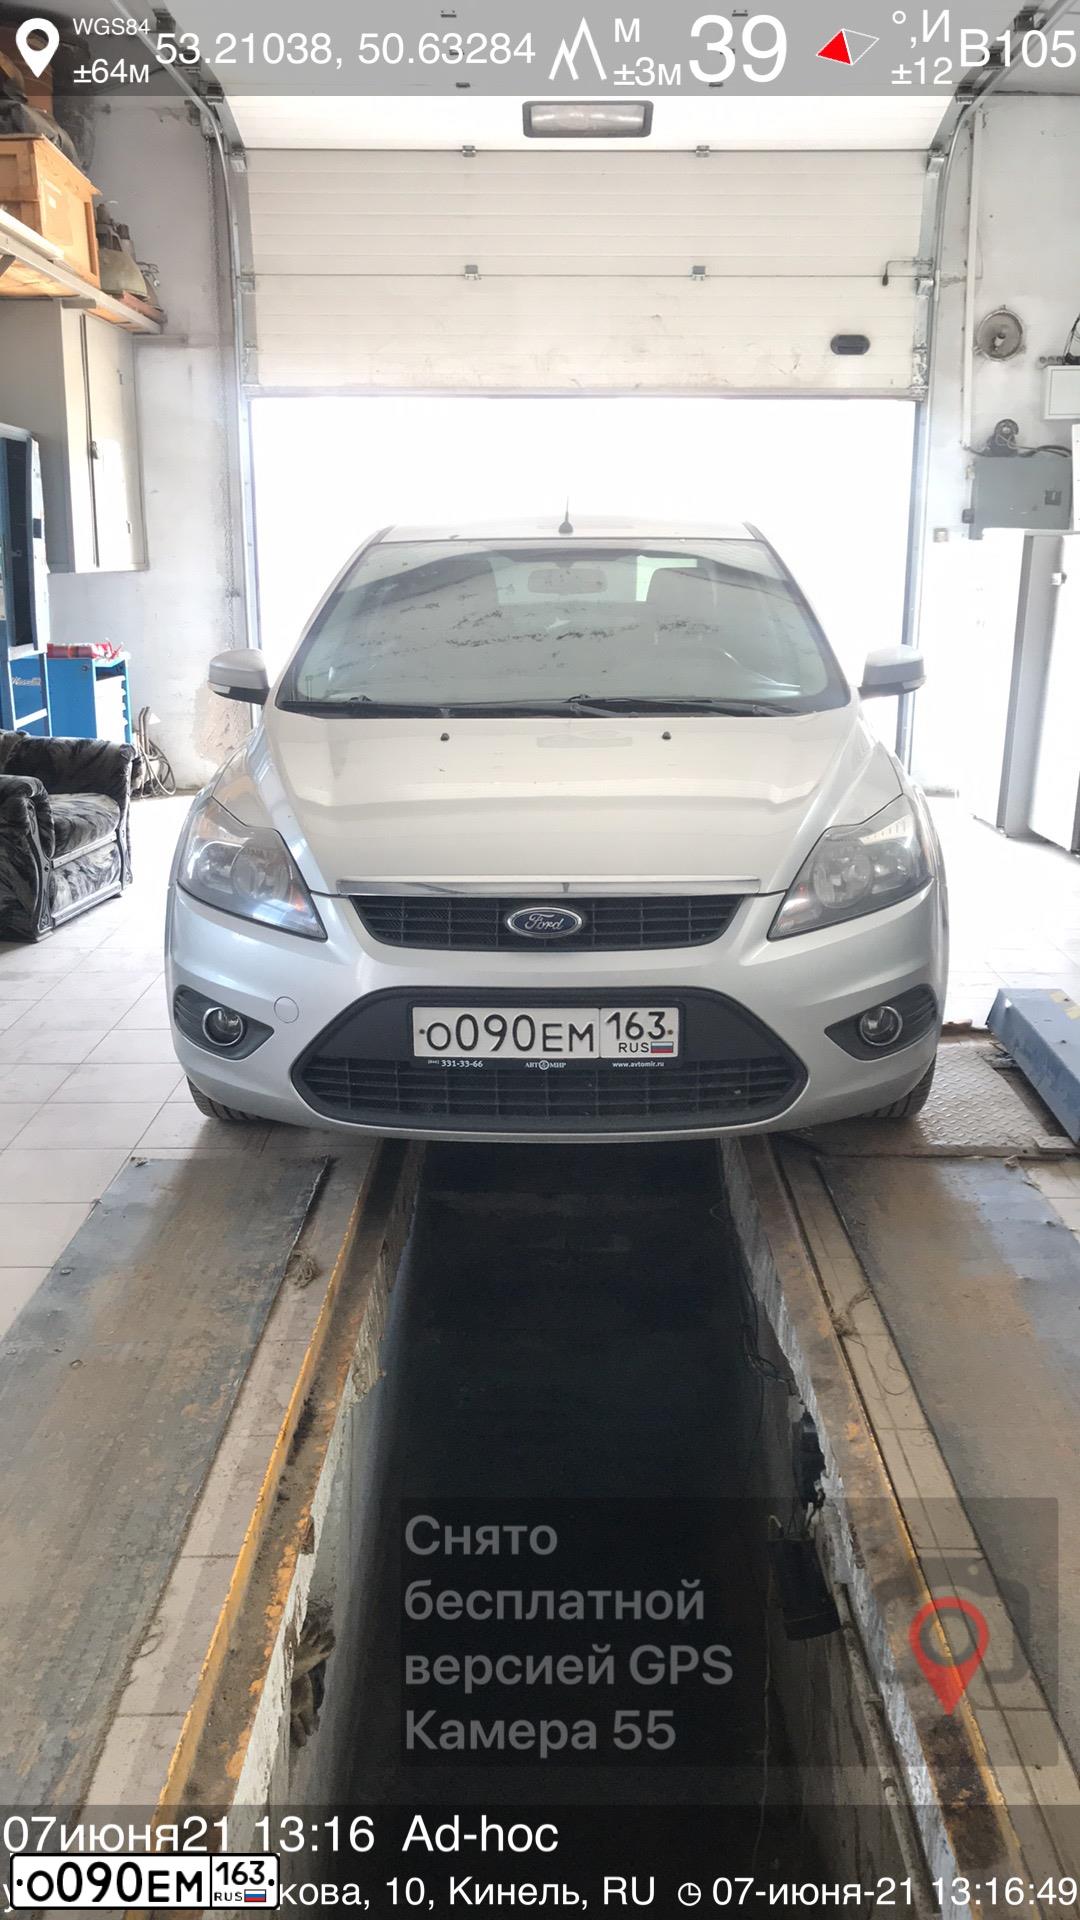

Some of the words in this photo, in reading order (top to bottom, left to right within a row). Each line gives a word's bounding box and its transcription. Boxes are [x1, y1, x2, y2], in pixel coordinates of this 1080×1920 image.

[524, 914, 564, 931] Ford
[605, 1011, 667, 1041] 163
[618, 1042, 650, 1054] RUS
[441, 1060, 483, 1068] 331-33-66
[612, 1060, 664, 1068] www.avtomir.ru
